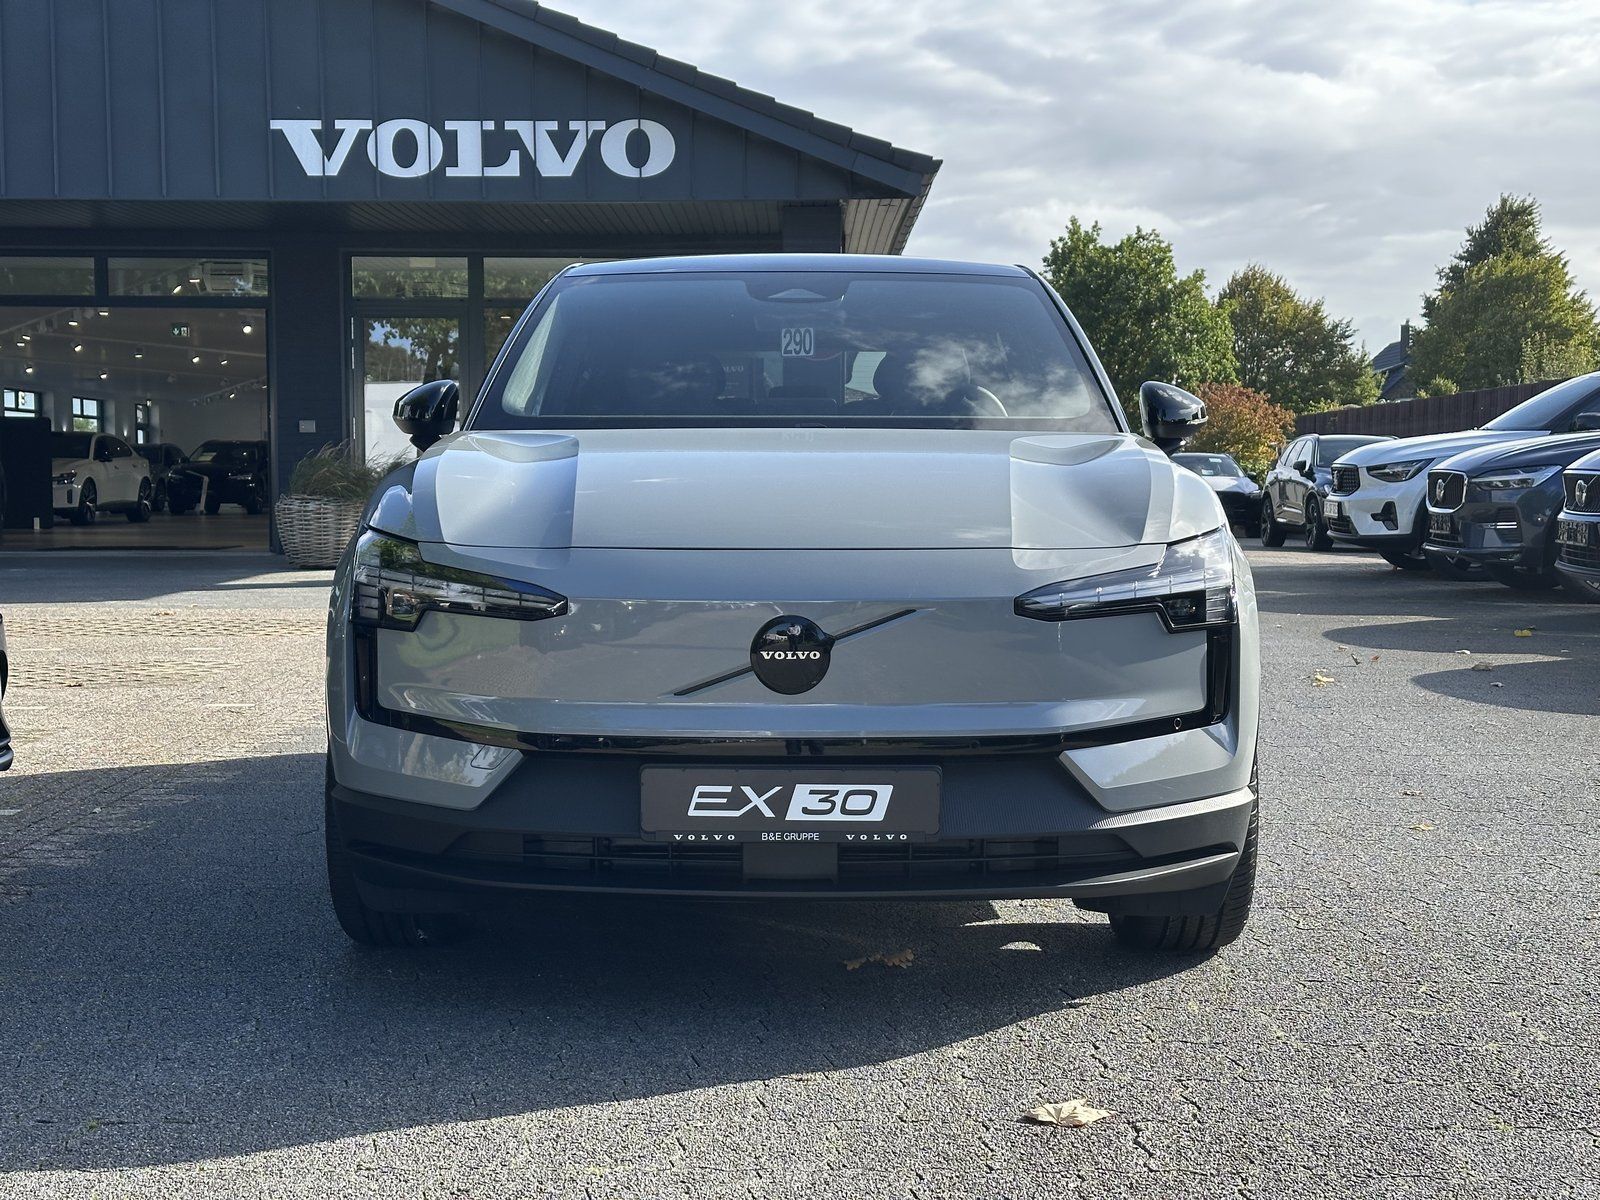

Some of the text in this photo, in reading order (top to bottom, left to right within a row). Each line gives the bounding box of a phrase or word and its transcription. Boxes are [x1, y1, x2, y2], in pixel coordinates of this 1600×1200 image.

[269, 118, 676, 178] VOLVO
[782, 328, 813, 355] 290
[760, 651, 821, 660] VOLVO
[687, 785, 879, 818] EX 30
[761, 832, 820, 841] B&E GRUPPE
[845, 833, 908, 841] VOLVO
